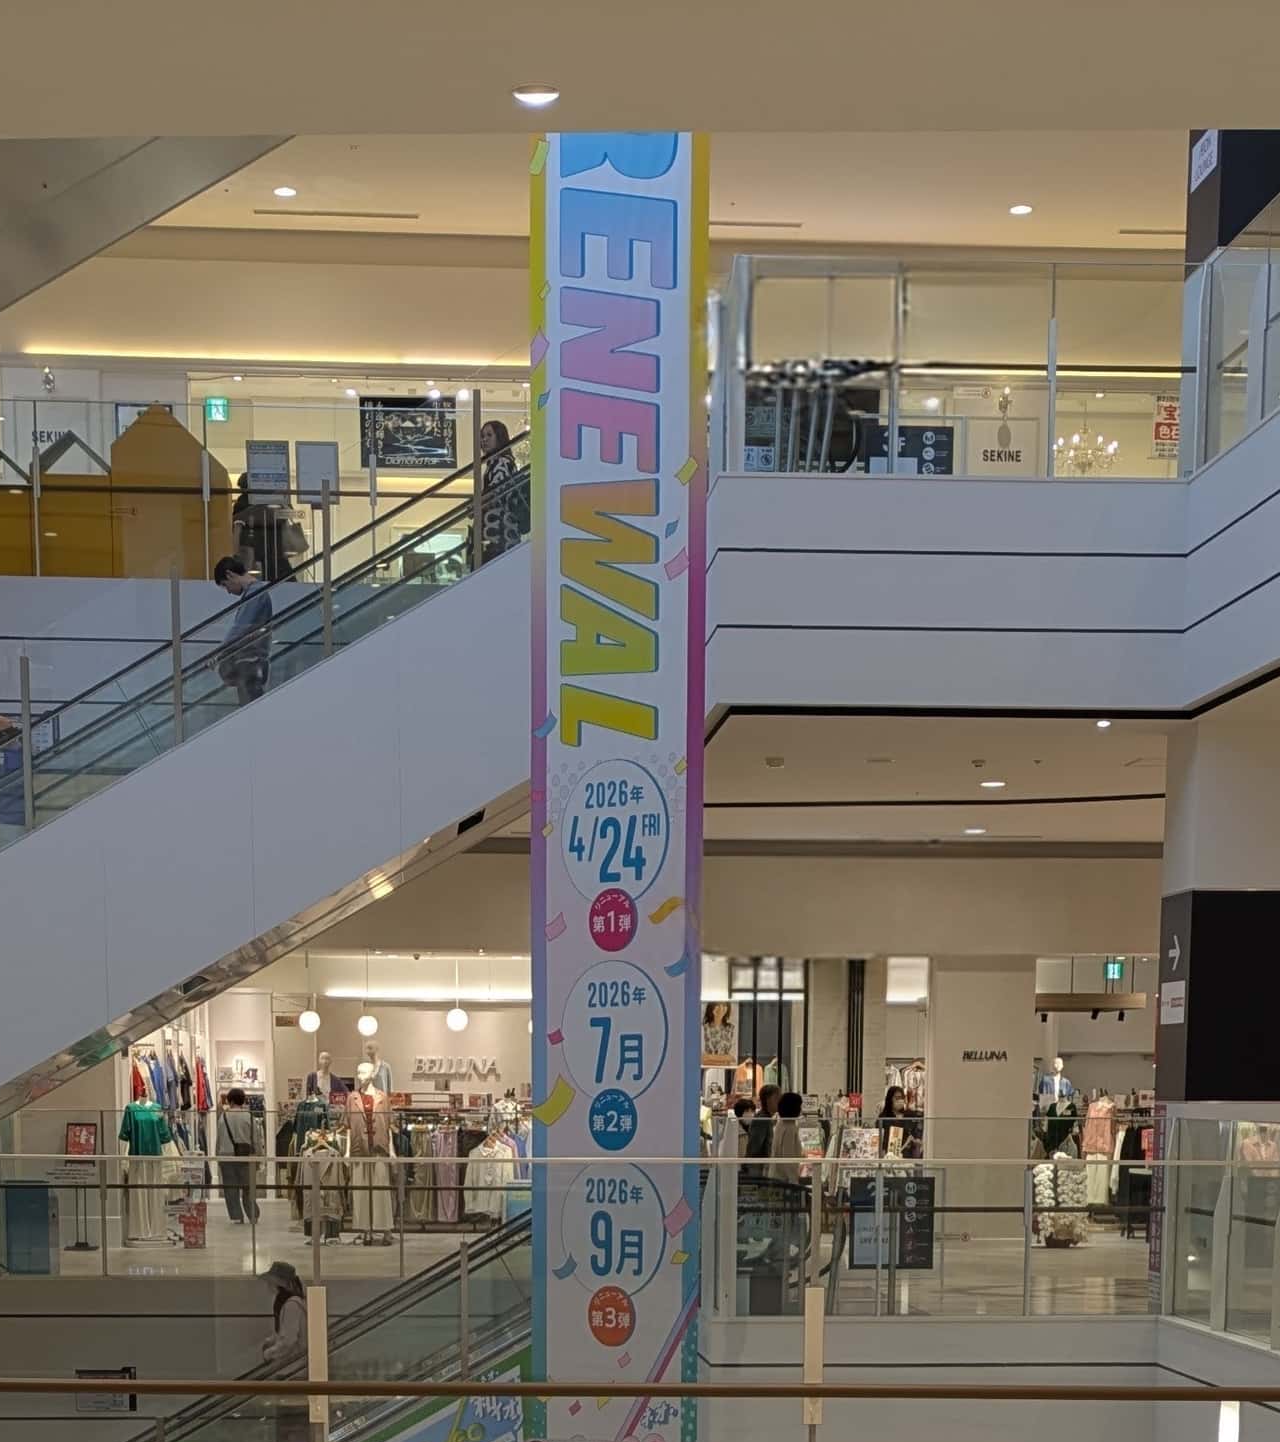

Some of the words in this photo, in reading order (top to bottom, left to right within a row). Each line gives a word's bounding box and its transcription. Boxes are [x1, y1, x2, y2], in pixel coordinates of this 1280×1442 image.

[560, 132, 678, 747] RENEWAL
[982, 449, 1022, 463] SEKINE
[584, 779, 645, 809] 2026年
[567, 814, 647, 884] 4/24
[642, 814, 661, 837] FRI
[592, 910, 632, 933] 第1弾
[587, 980, 647, 1008] 2026年
[590, 1016, 644, 1084] 7月
[962, 1050, 1008, 1062] BELLUNA
[413, 1056, 500, 1078] BELLUNA
[592, 1110, 633, 1133] 第2弾
[585, 1177, 644, 1204] 2026年
[590, 1210, 643, 1277] 9月
[591, 1306, 632, 1330] 第3弾
